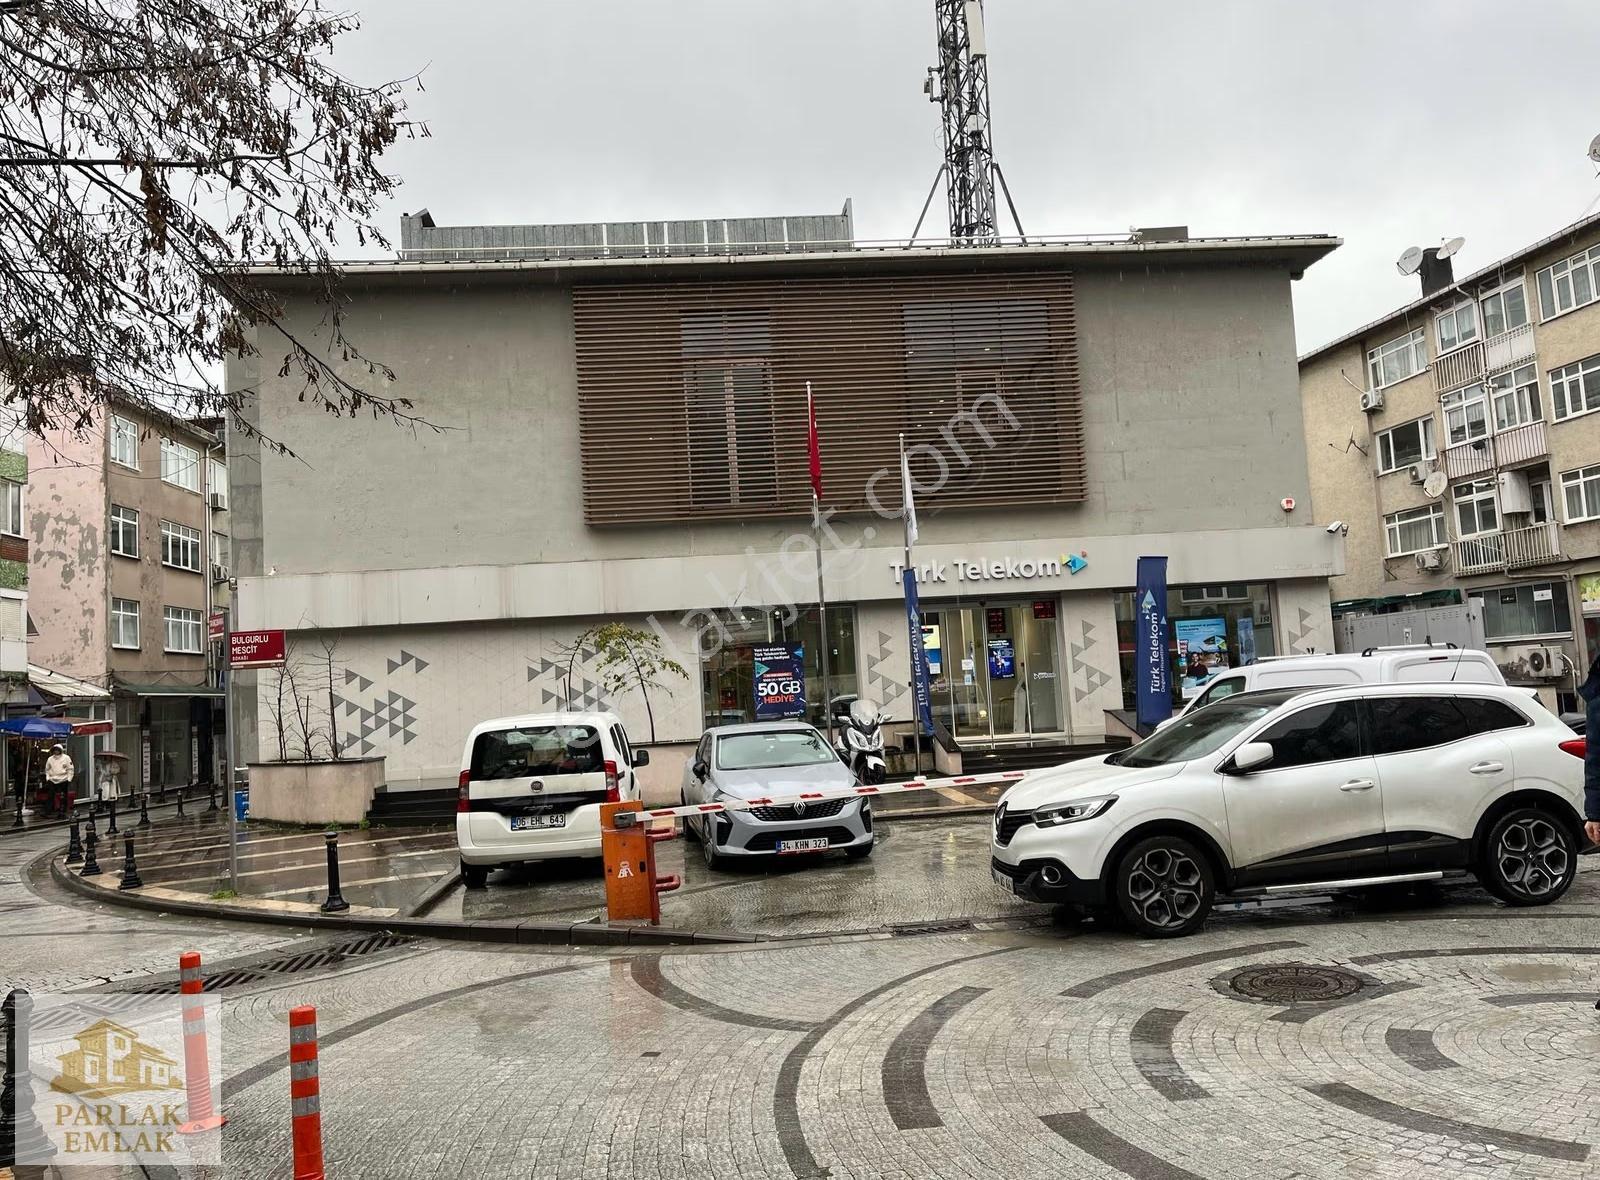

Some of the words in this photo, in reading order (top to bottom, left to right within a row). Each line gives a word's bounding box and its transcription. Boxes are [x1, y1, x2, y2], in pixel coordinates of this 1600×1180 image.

[953, 556, 1062, 582] Telekom
[231, 634, 269, 645] BULGURLU
[1150, 612, 1159, 664] Telekom
[231, 645, 258, 655] MESCİT
[1150, 667, 1161, 694] Türk
[758, 682, 779, 696] 50
[780, 680, 801, 694] GB
[763, 694, 794, 704] HEDİYE
[516, 817, 526, 827] 06
[550, 814, 564, 824] 643
[781, 842, 790, 851] 34
[795, 840, 810, 849] KHN
[813, 839, 826, 848] 323
